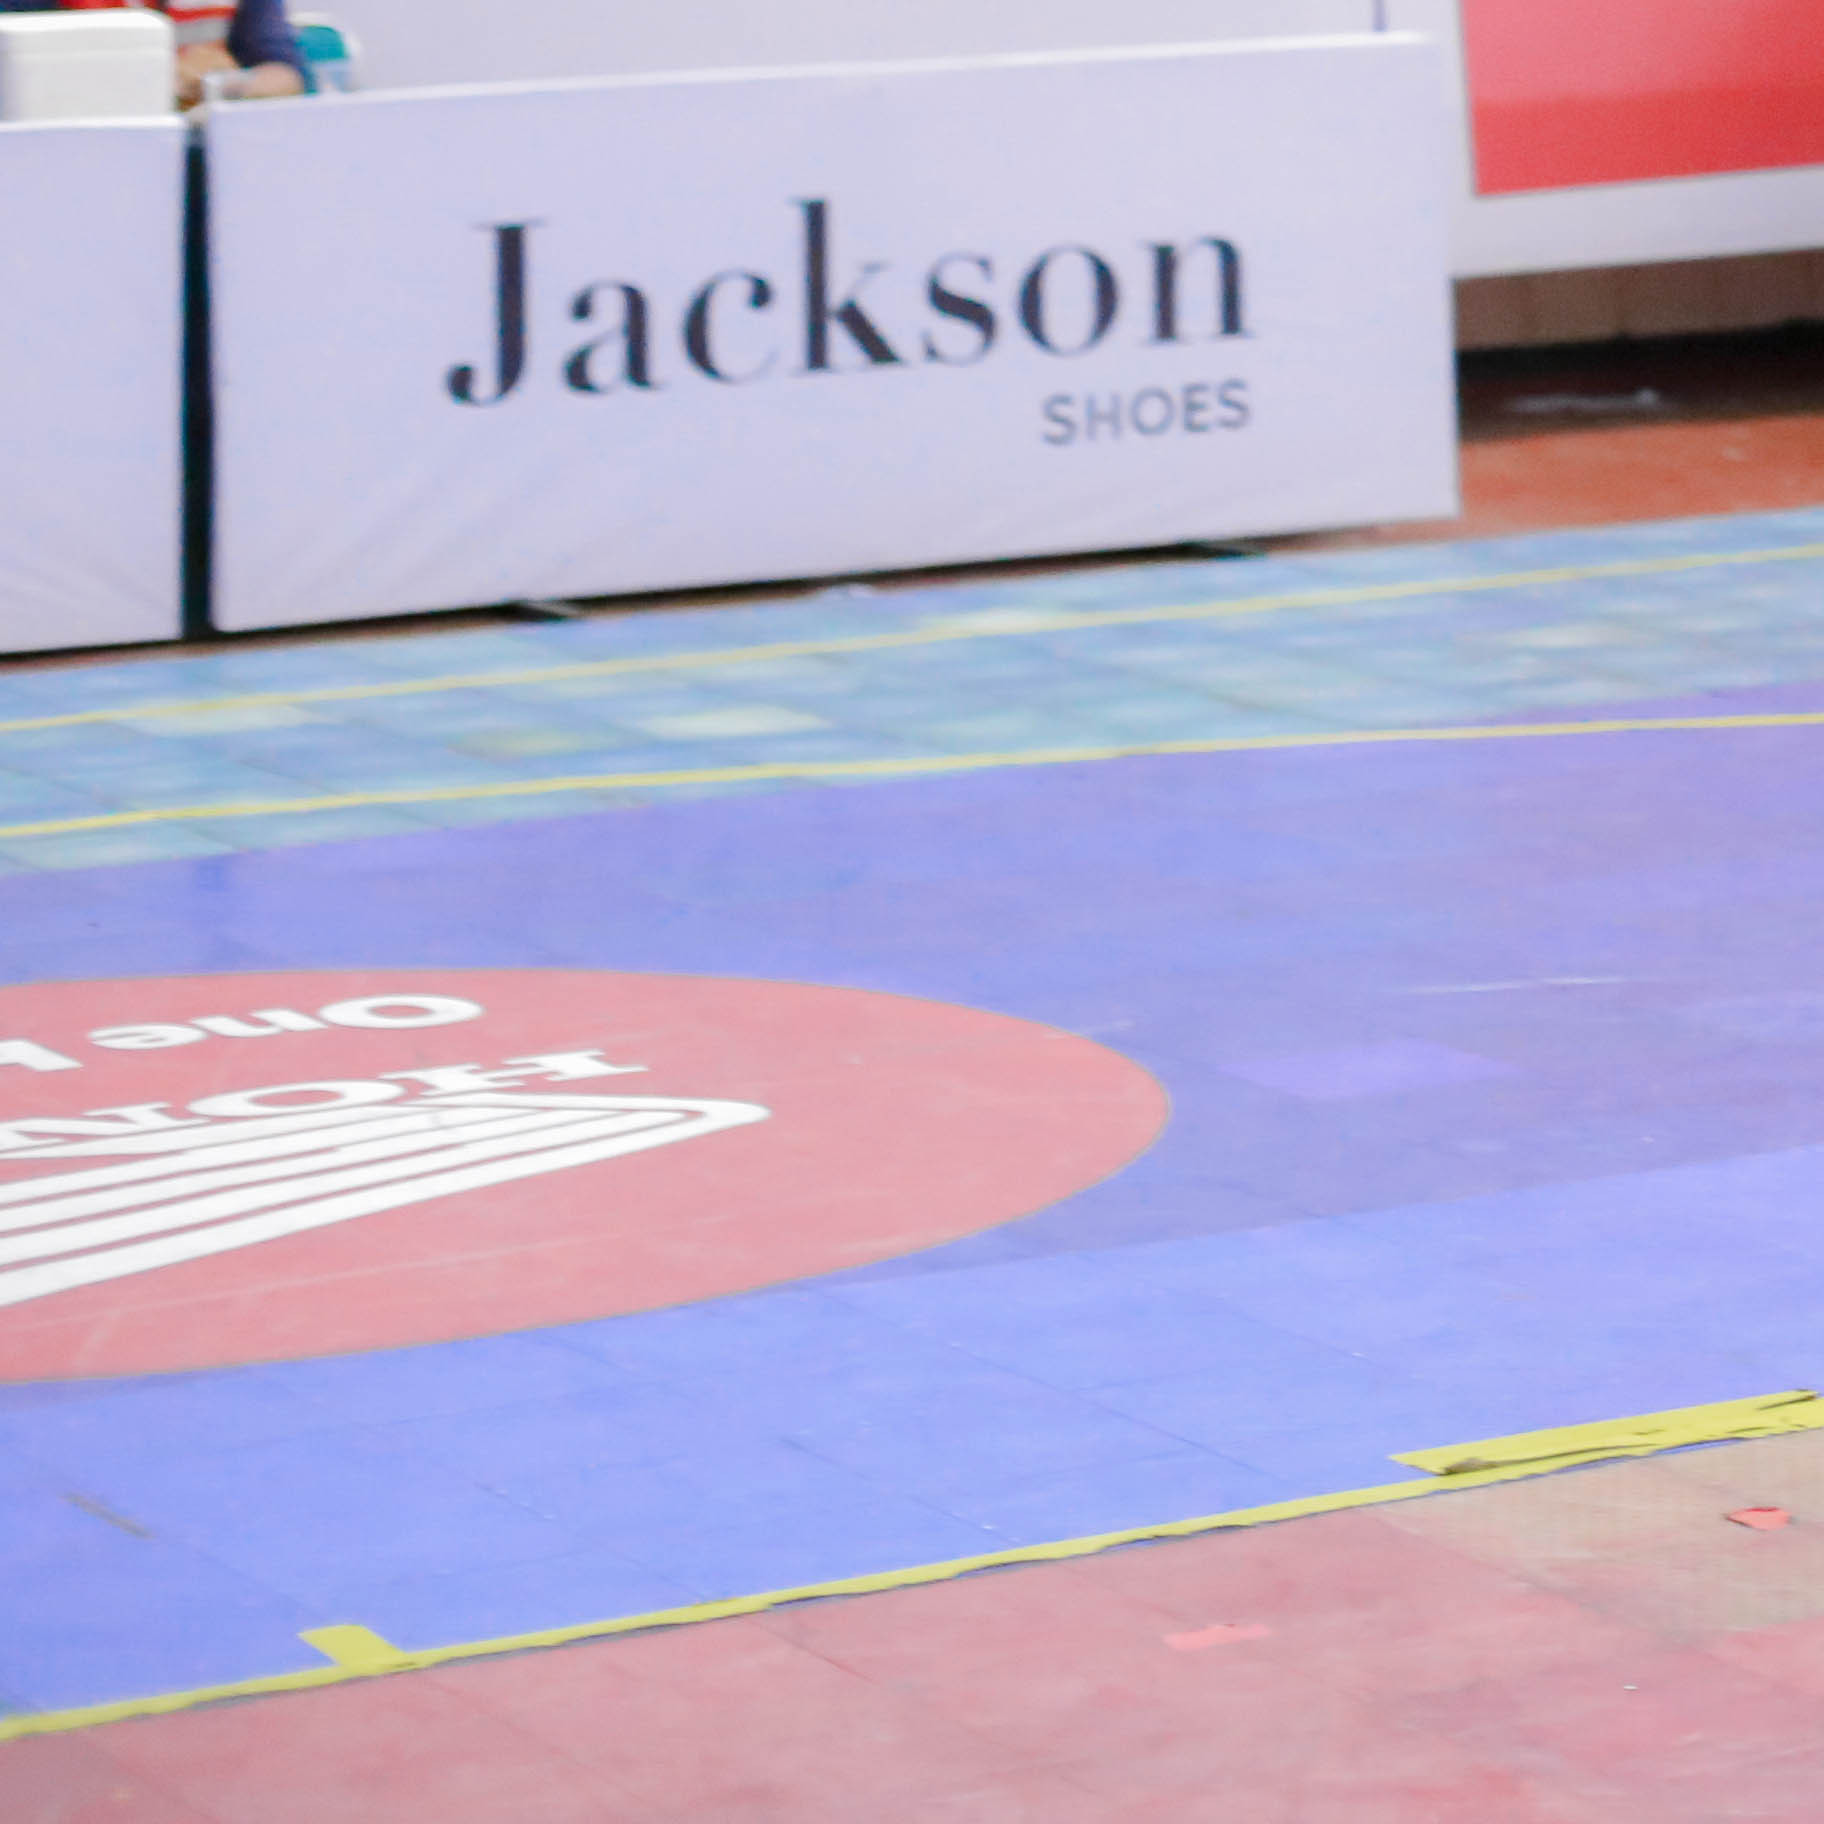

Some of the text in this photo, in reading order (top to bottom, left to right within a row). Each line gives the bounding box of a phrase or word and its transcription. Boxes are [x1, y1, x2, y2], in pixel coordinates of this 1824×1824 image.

[443, 196, 1256, 409] Jackson
[1040, 376, 1256, 448] SHOES
[86, 993, 487, 1052] One
